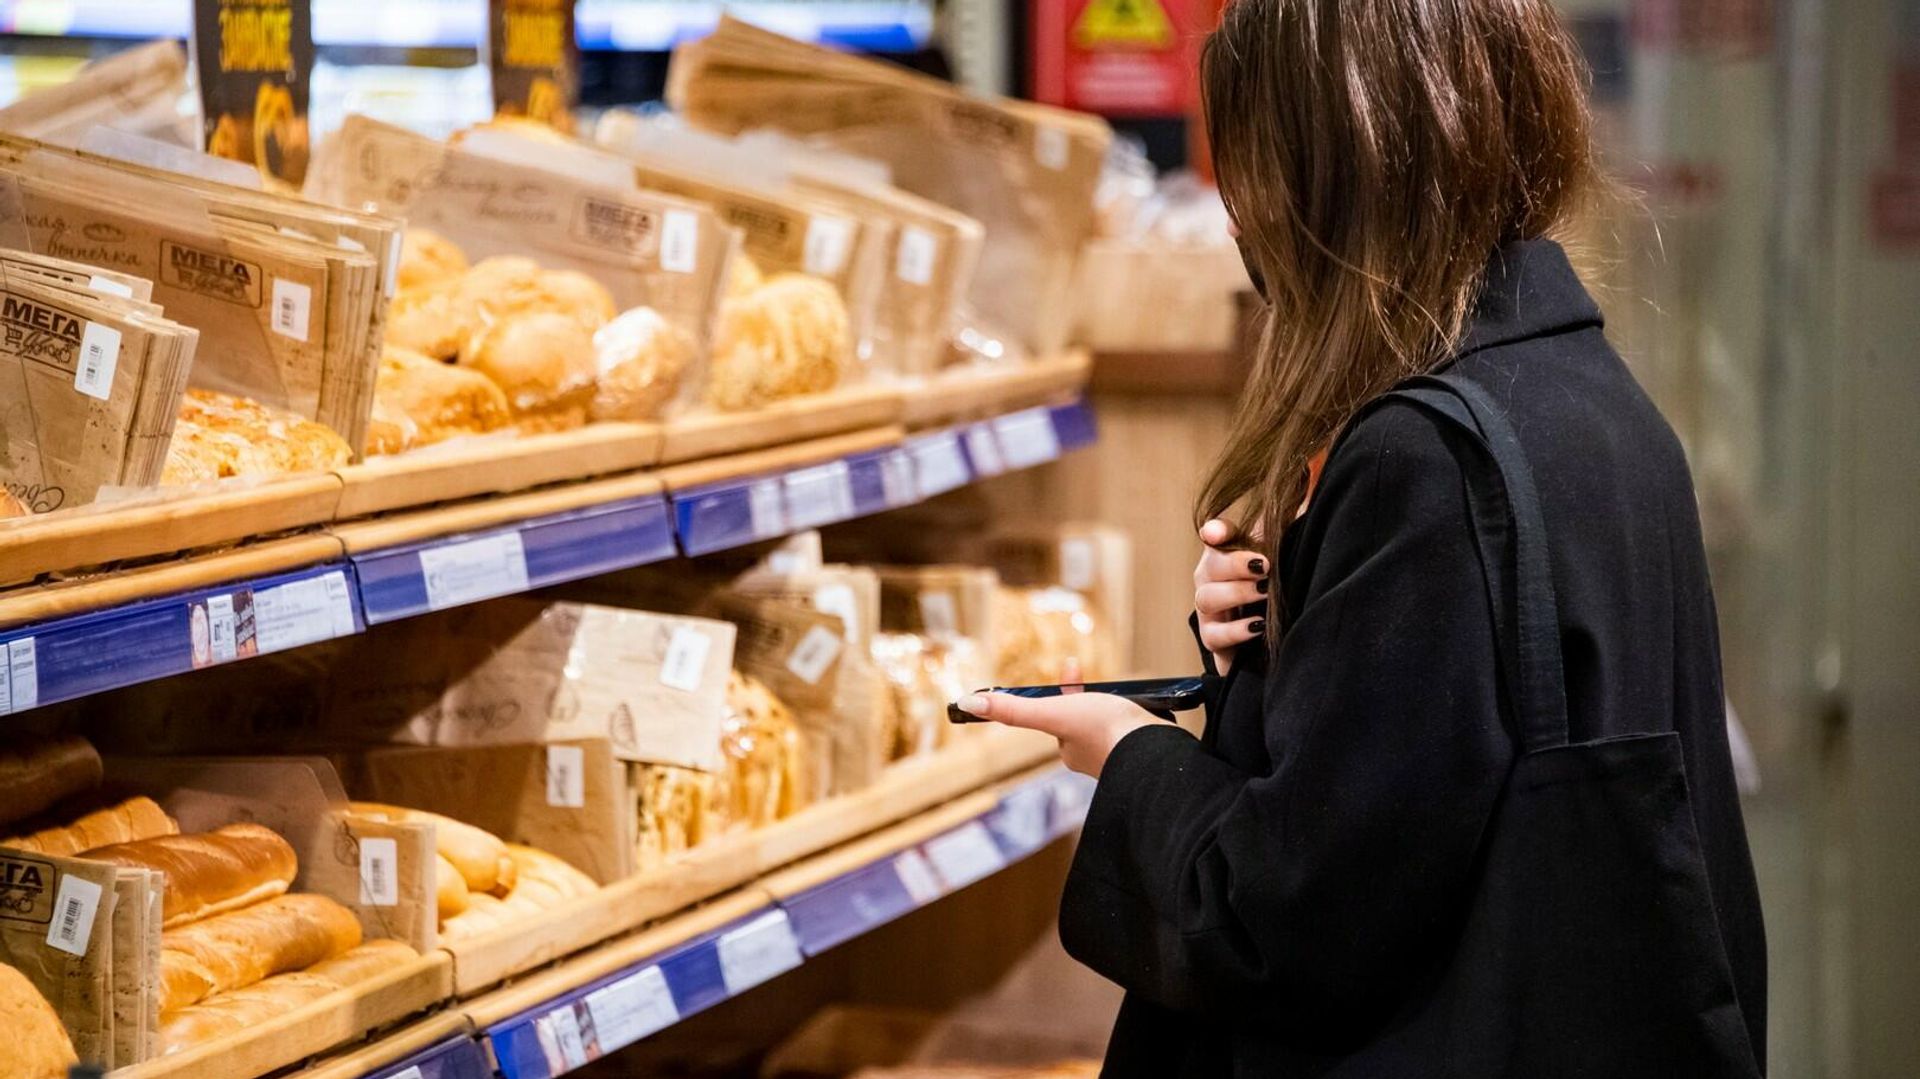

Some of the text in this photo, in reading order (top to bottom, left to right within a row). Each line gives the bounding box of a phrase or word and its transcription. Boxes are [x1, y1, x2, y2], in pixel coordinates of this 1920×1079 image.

[171, 246, 250, 282] МЕГА
[2, 297, 80, 340] МЕГА
[0, 861, 43, 887] ГА
